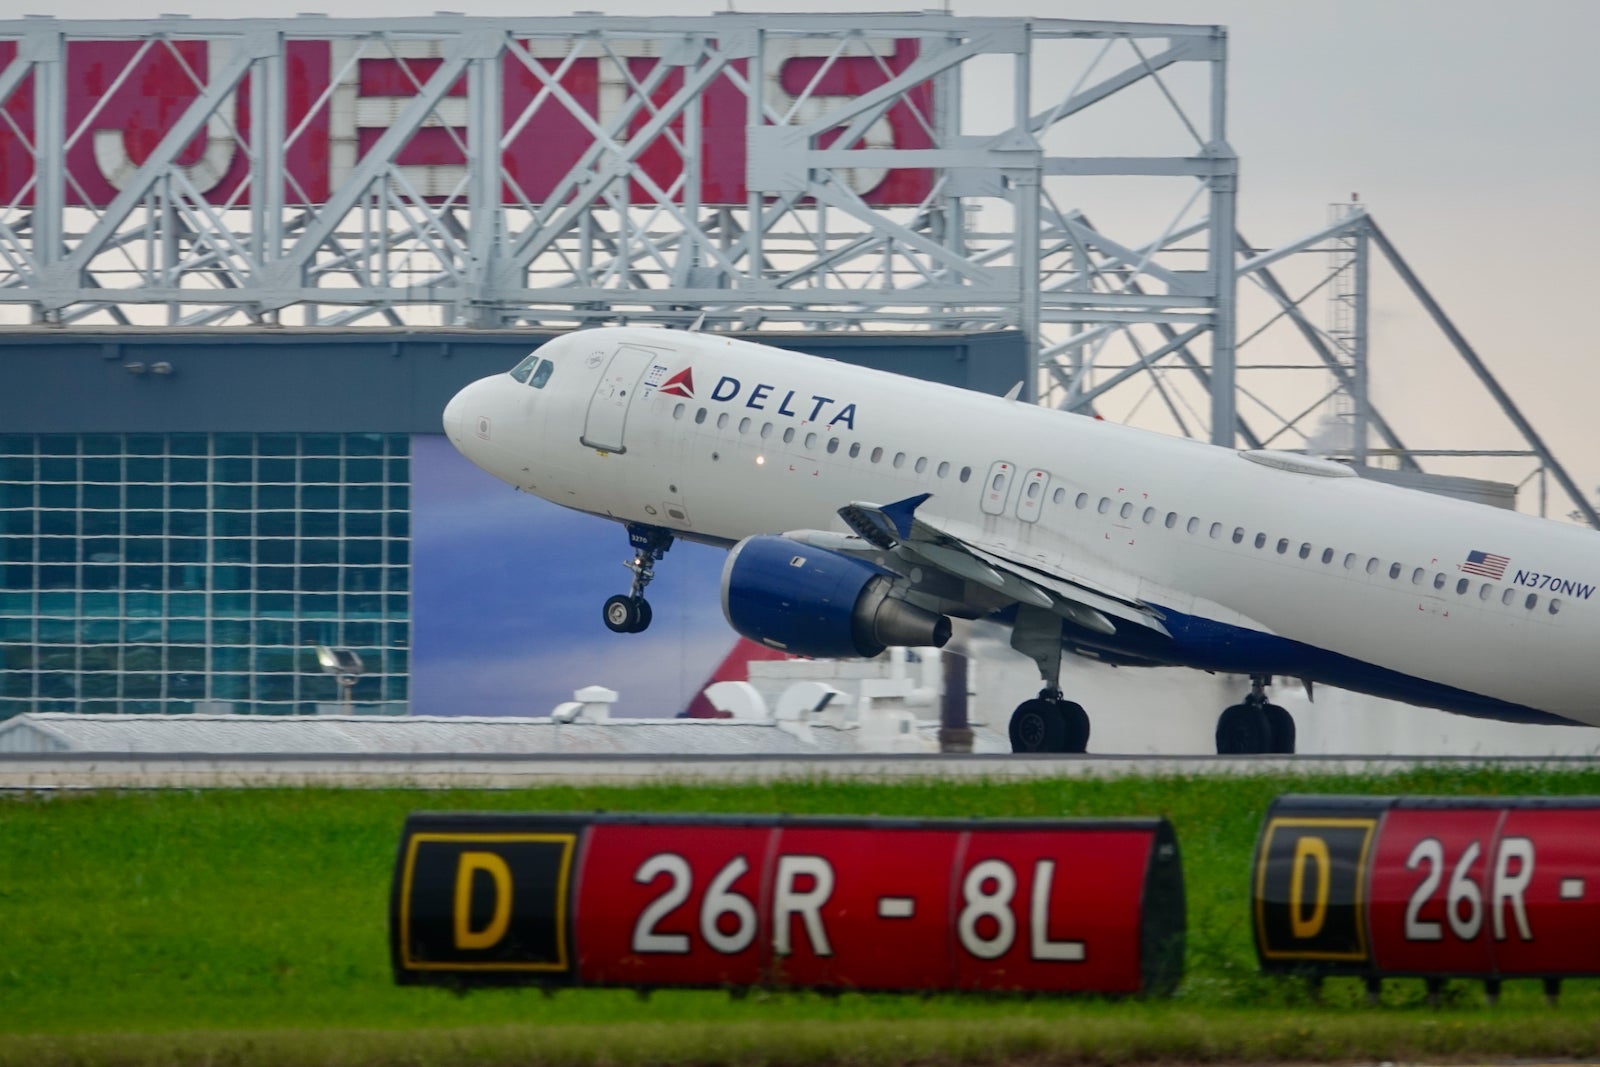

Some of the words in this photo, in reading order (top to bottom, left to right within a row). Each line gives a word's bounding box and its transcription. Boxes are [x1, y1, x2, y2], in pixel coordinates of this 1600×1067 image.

[710, 376, 856, 430] DELTA
[1513, 569, 1596, 600] N370NW
[453, 851, 513, 951] D
[1290, 836, 1331, 938] D
